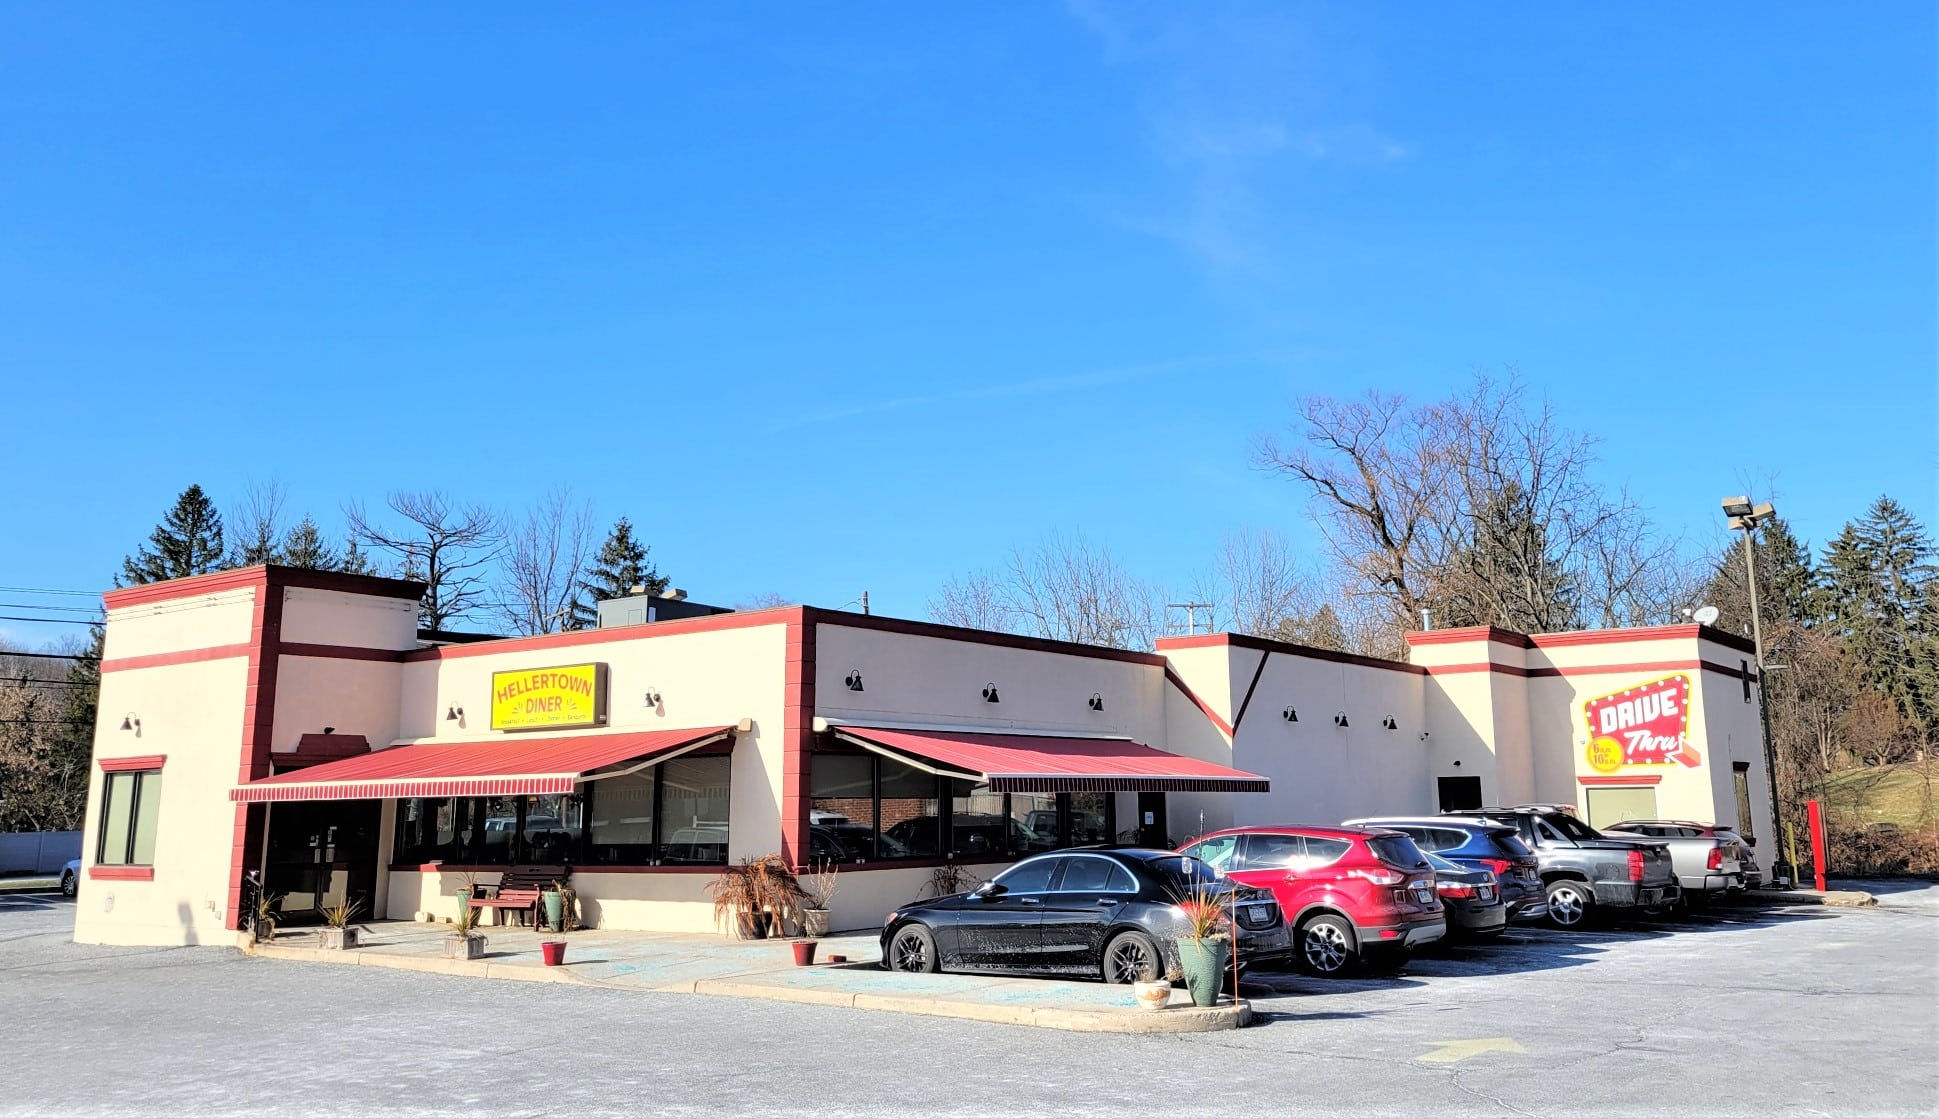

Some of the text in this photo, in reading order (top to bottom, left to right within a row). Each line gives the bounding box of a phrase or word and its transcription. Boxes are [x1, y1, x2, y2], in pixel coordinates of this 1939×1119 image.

[497, 673, 592, 704] HELLERTOWN
[525, 696, 562, 714] DINER
[1600, 688, 1679, 735] DRIVE
[1623, 730, 1678, 755] Thru
